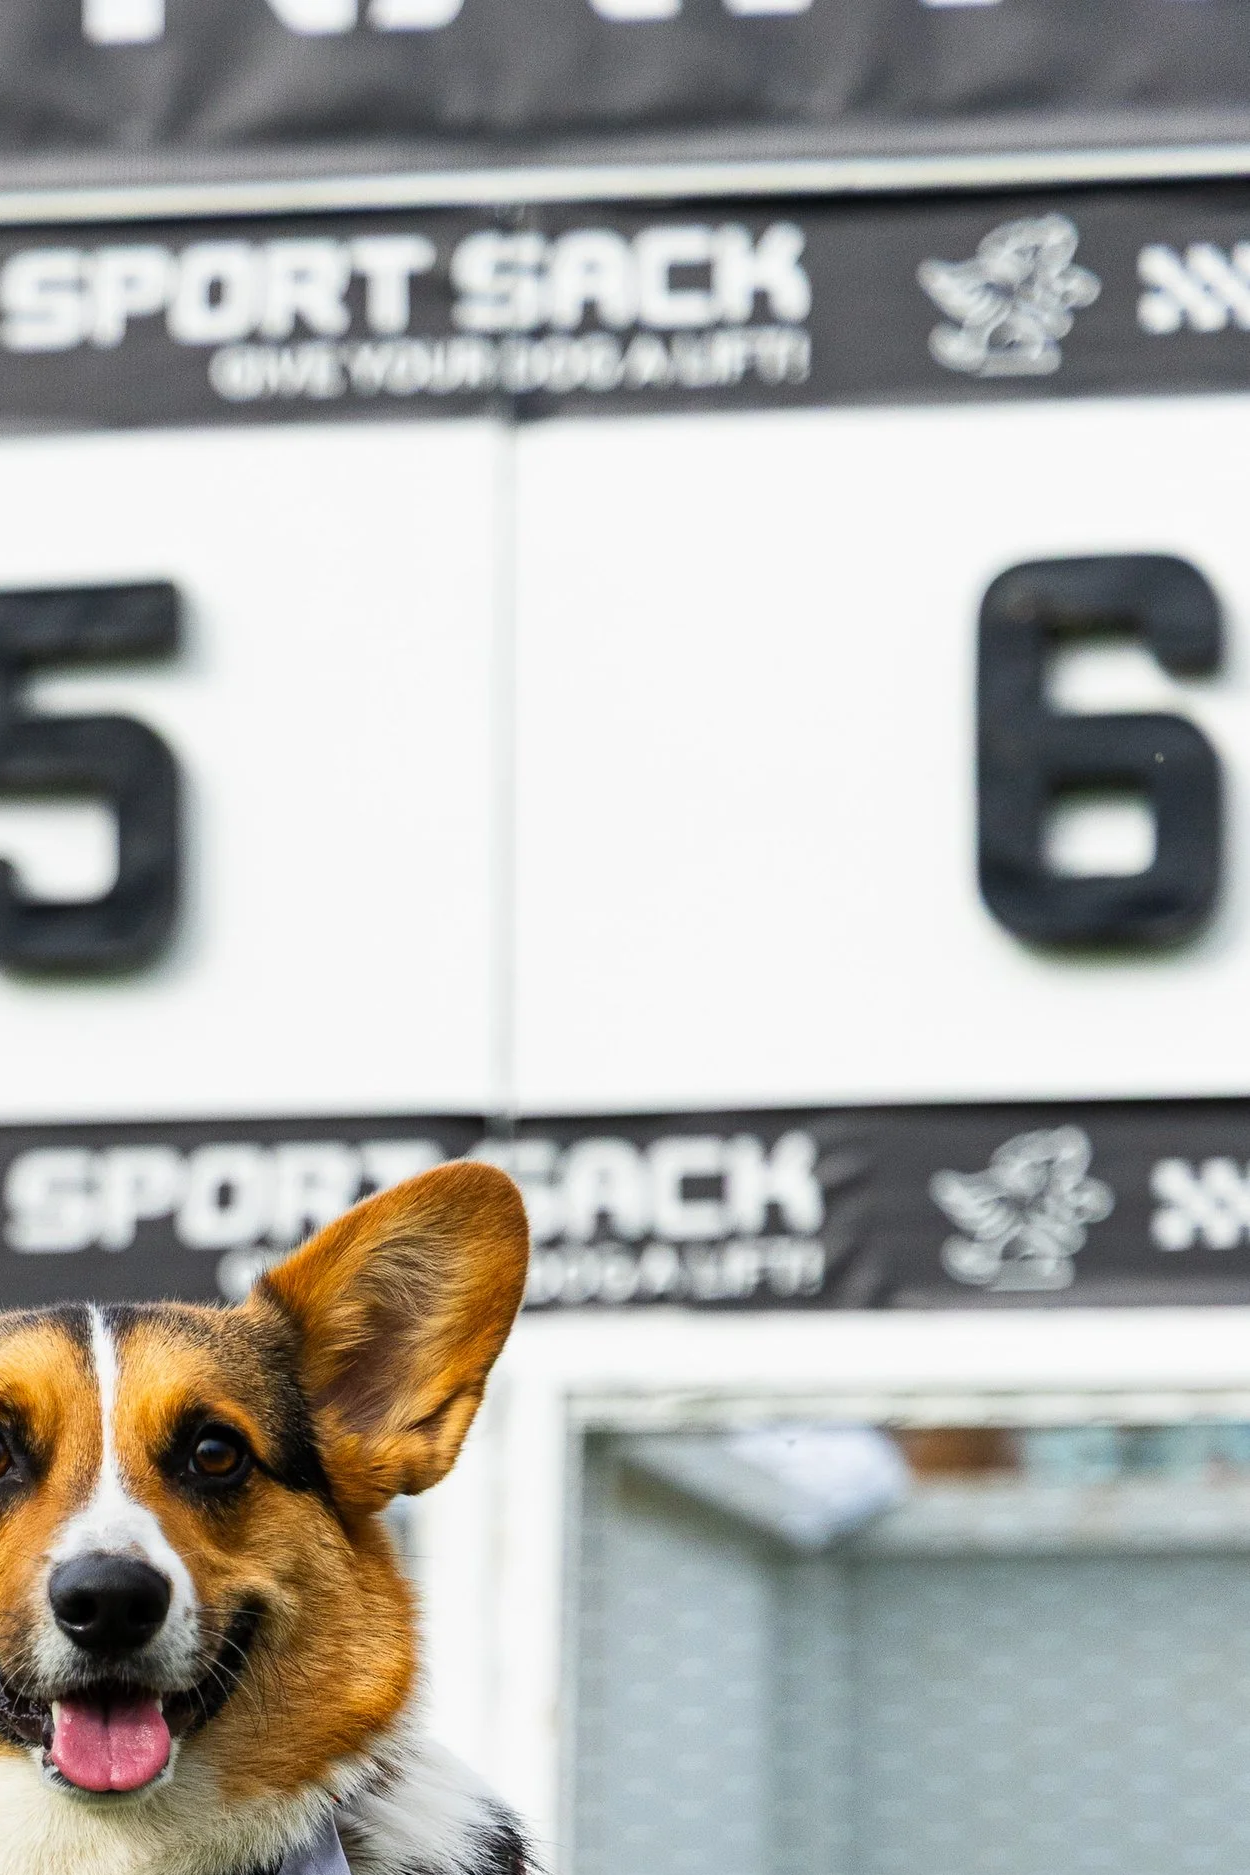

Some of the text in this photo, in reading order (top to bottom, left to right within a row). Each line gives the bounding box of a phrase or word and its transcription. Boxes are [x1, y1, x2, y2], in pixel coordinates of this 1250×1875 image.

[450, 223, 813, 332] SACK
[350, 335, 494, 396] YOUR
[974, 552, 1230, 967] 6
